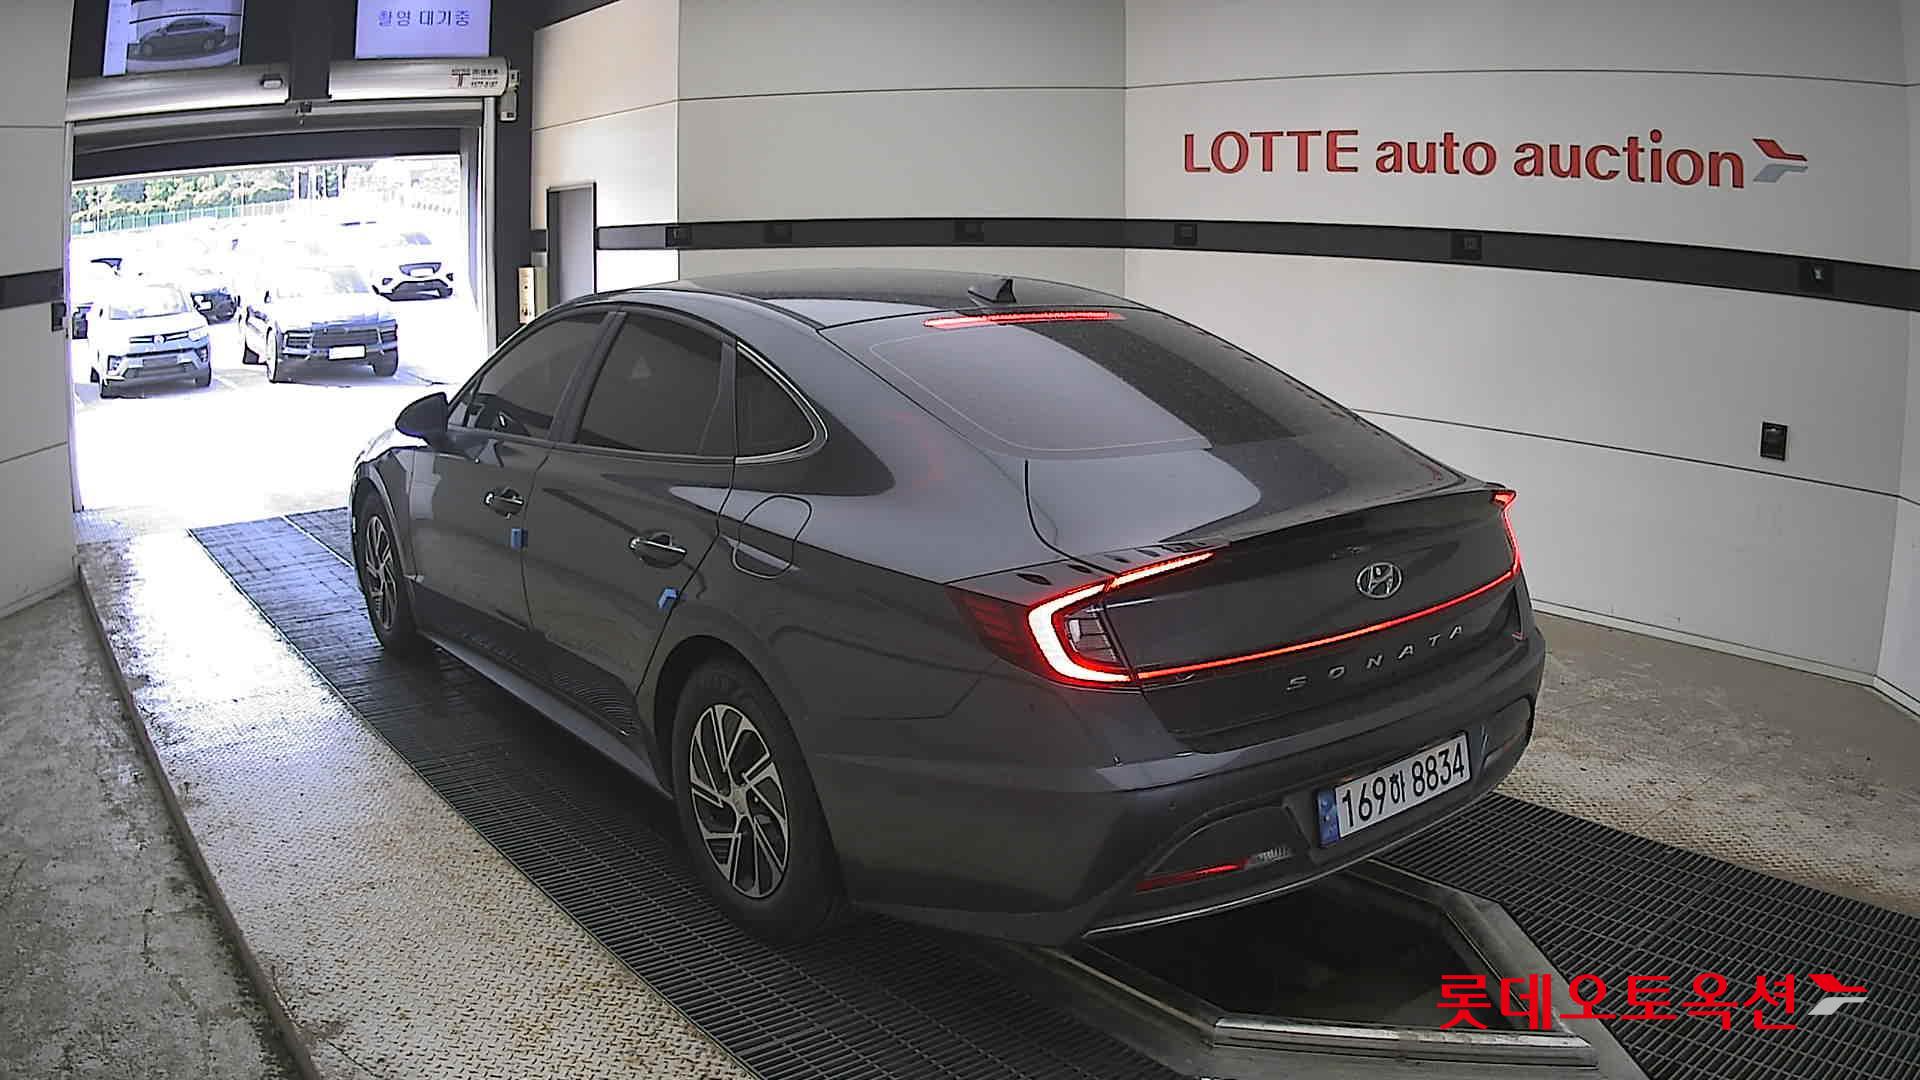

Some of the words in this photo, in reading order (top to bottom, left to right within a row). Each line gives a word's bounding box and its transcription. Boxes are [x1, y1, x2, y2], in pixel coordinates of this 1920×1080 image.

[419, 10, 470, 26] 대기중
[1184, 129, 1359, 174] LOTTE
[1375, 132, 1497, 176] auto
[1514, 129, 1745, 189] auction
[1286, 625, 1463, 691] SONATA
[1342, 770, 1406, 828] 169하
[1411, 742, 1466, 797] 8834
